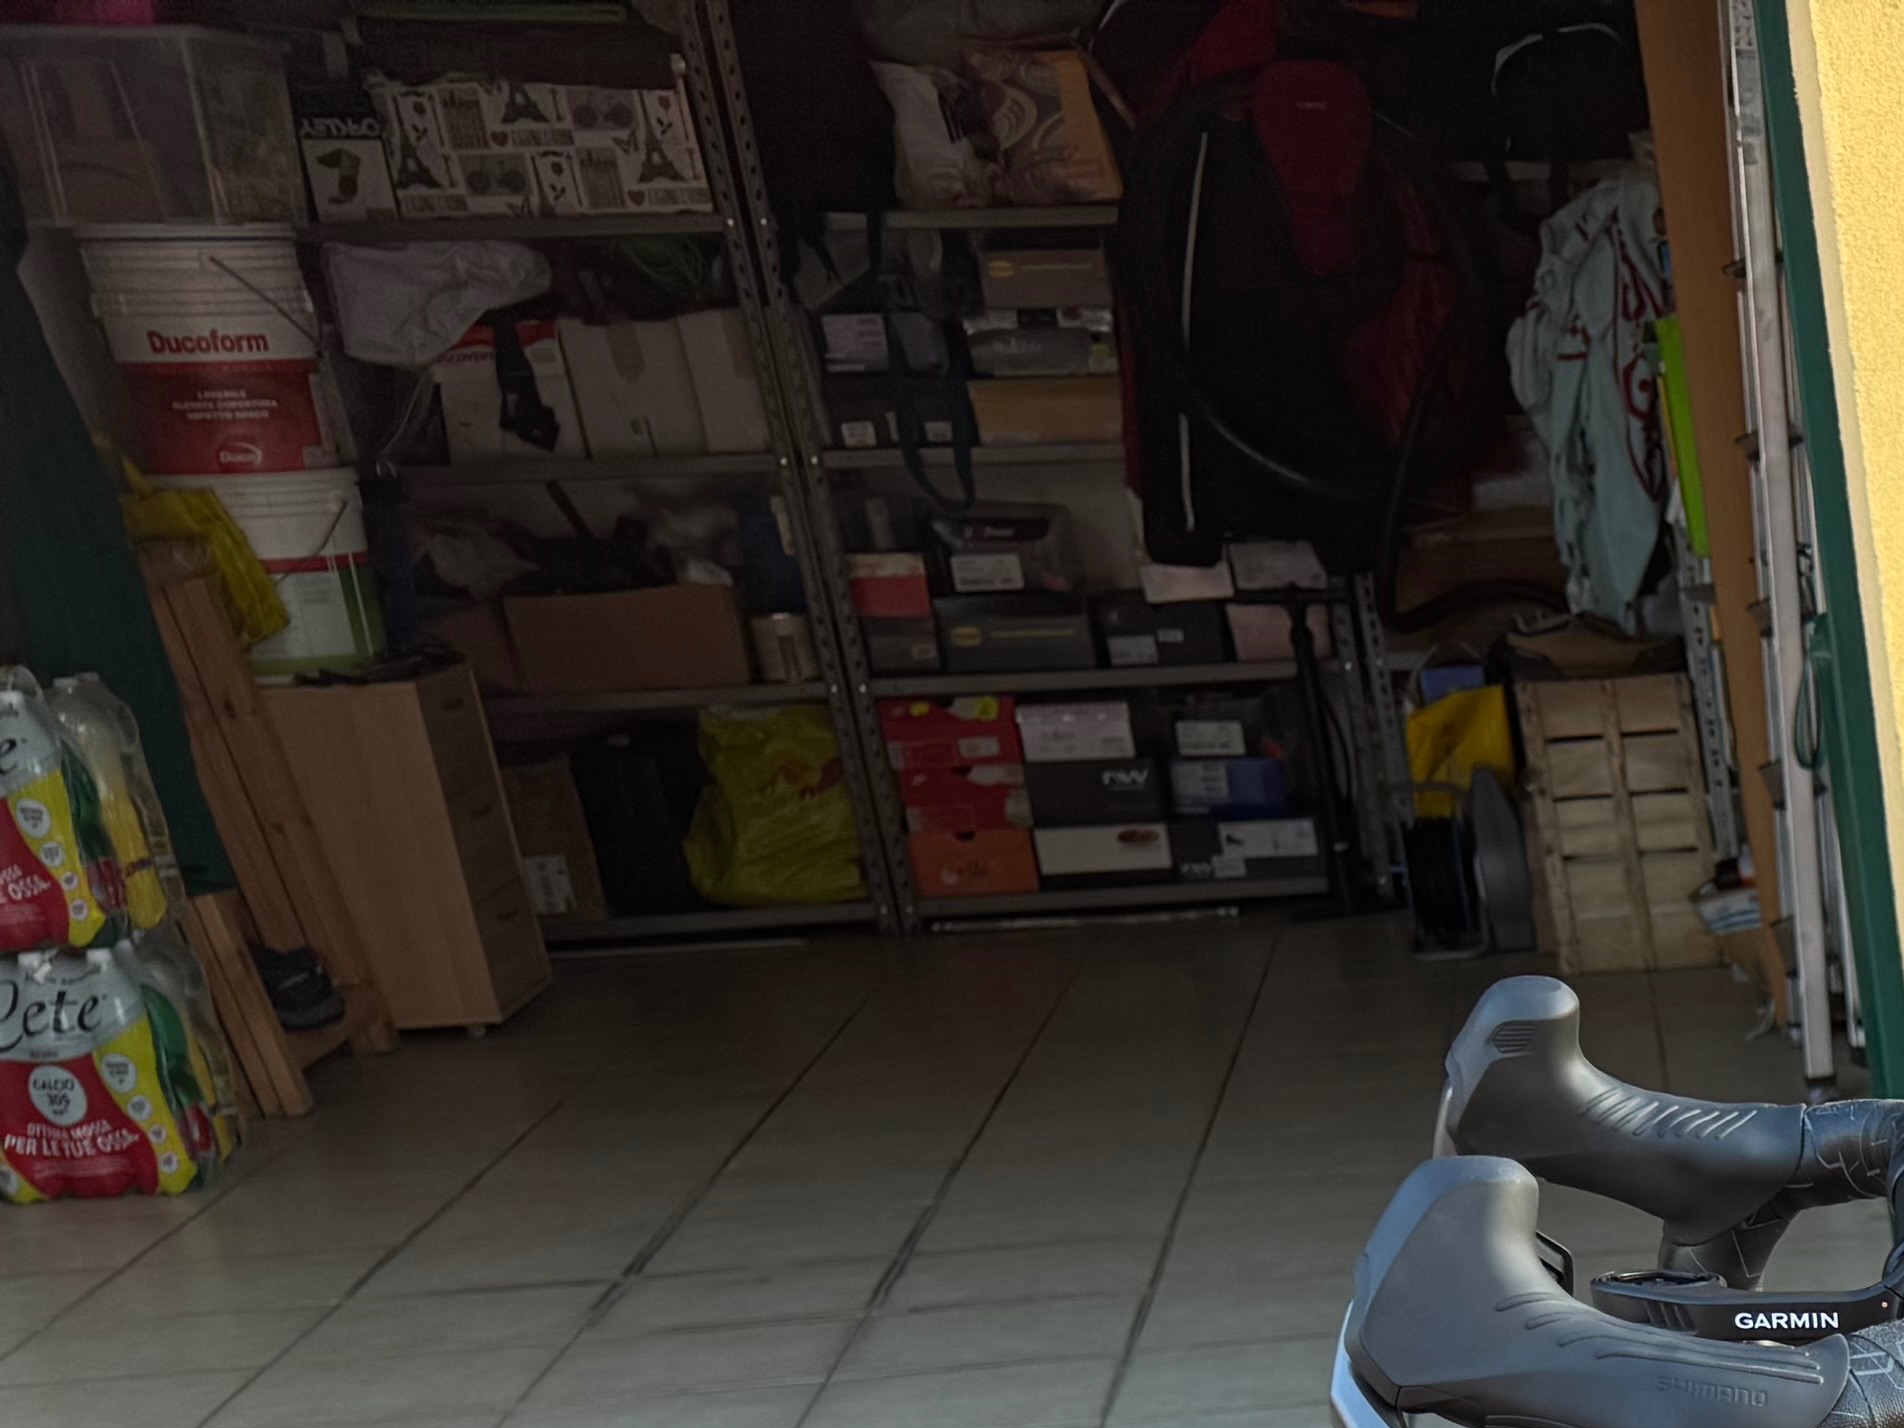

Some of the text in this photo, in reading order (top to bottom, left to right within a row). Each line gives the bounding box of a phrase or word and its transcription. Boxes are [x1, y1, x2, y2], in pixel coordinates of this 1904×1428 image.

[147, 328, 270, 354] Ducoform
[4, 1133, 37, 1155] PER
[41, 1136, 61, 1157] LE
[62, 1137, 97, 1159] TUE
[1735, 1312, 1839, 1329] GARMIN
[1655, 1375, 1768, 1407] SHIMANO
